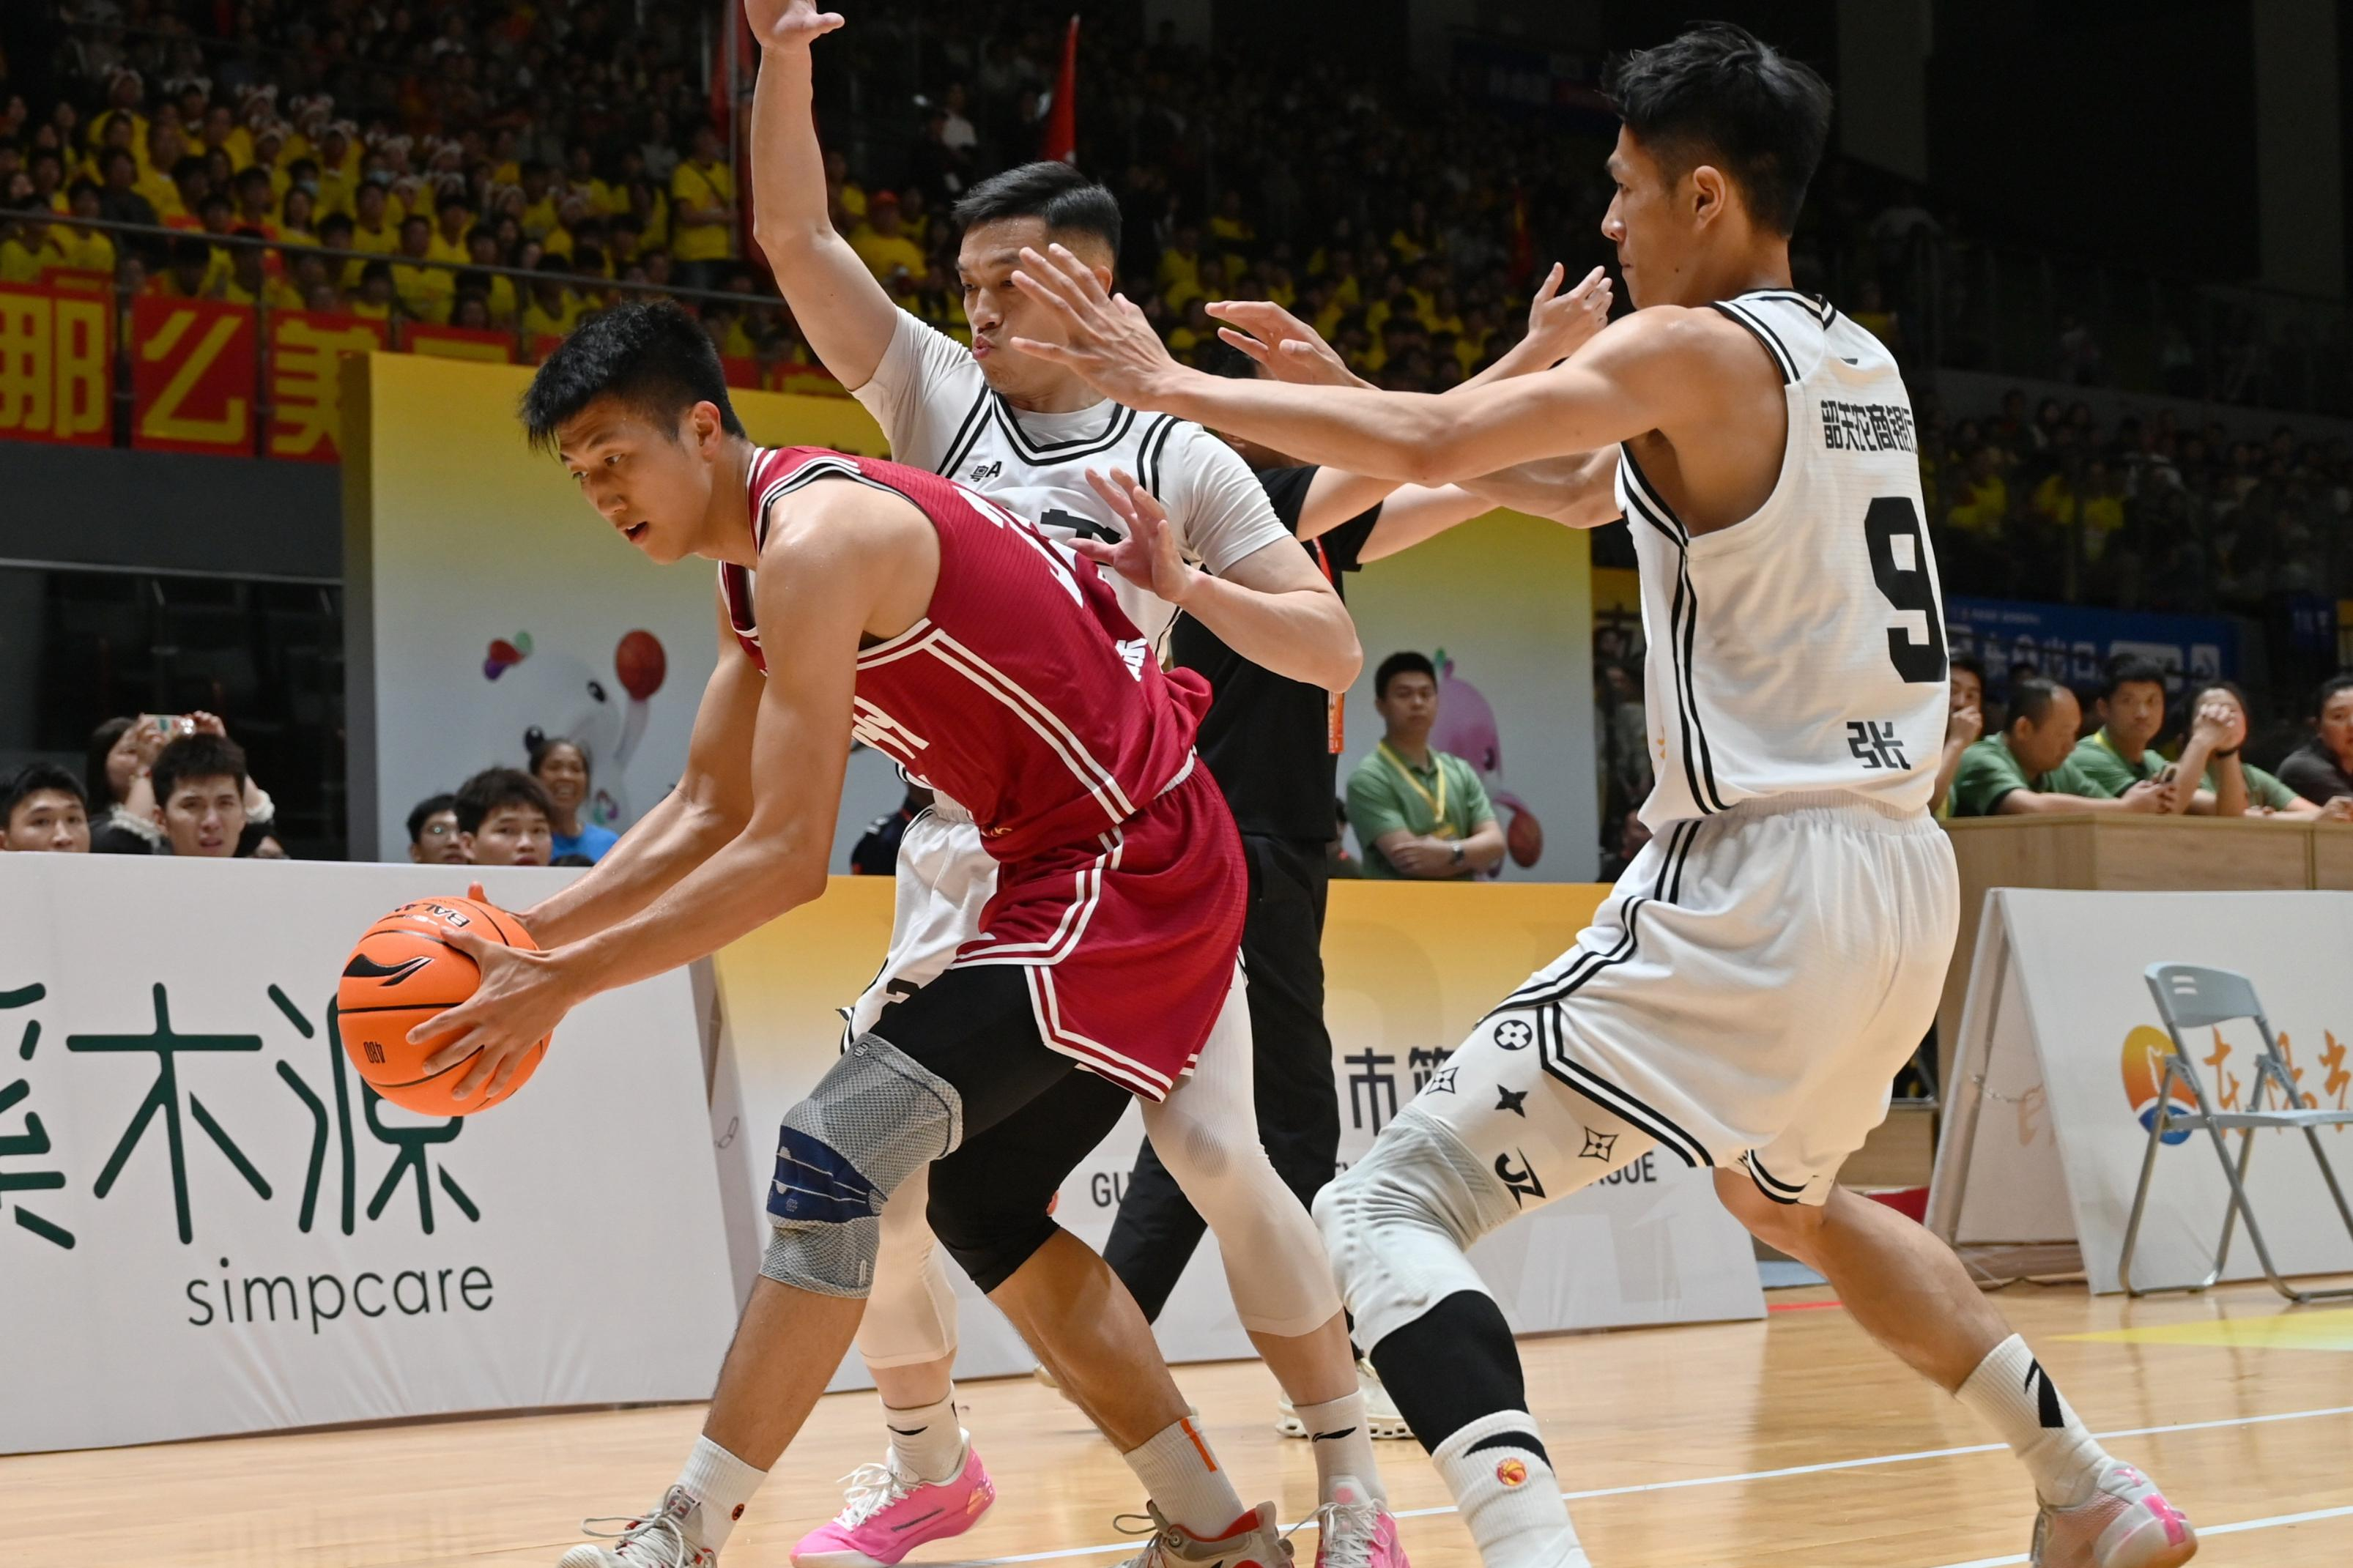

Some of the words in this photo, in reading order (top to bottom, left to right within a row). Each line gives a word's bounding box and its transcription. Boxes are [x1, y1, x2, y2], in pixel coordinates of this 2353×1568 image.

[1864, 497, 1948, 683] 9
[1846, 721, 1911, 770] 张
[363, 1041, 386, 1064] 480
[186, 1257, 494, 1334] simpcare
